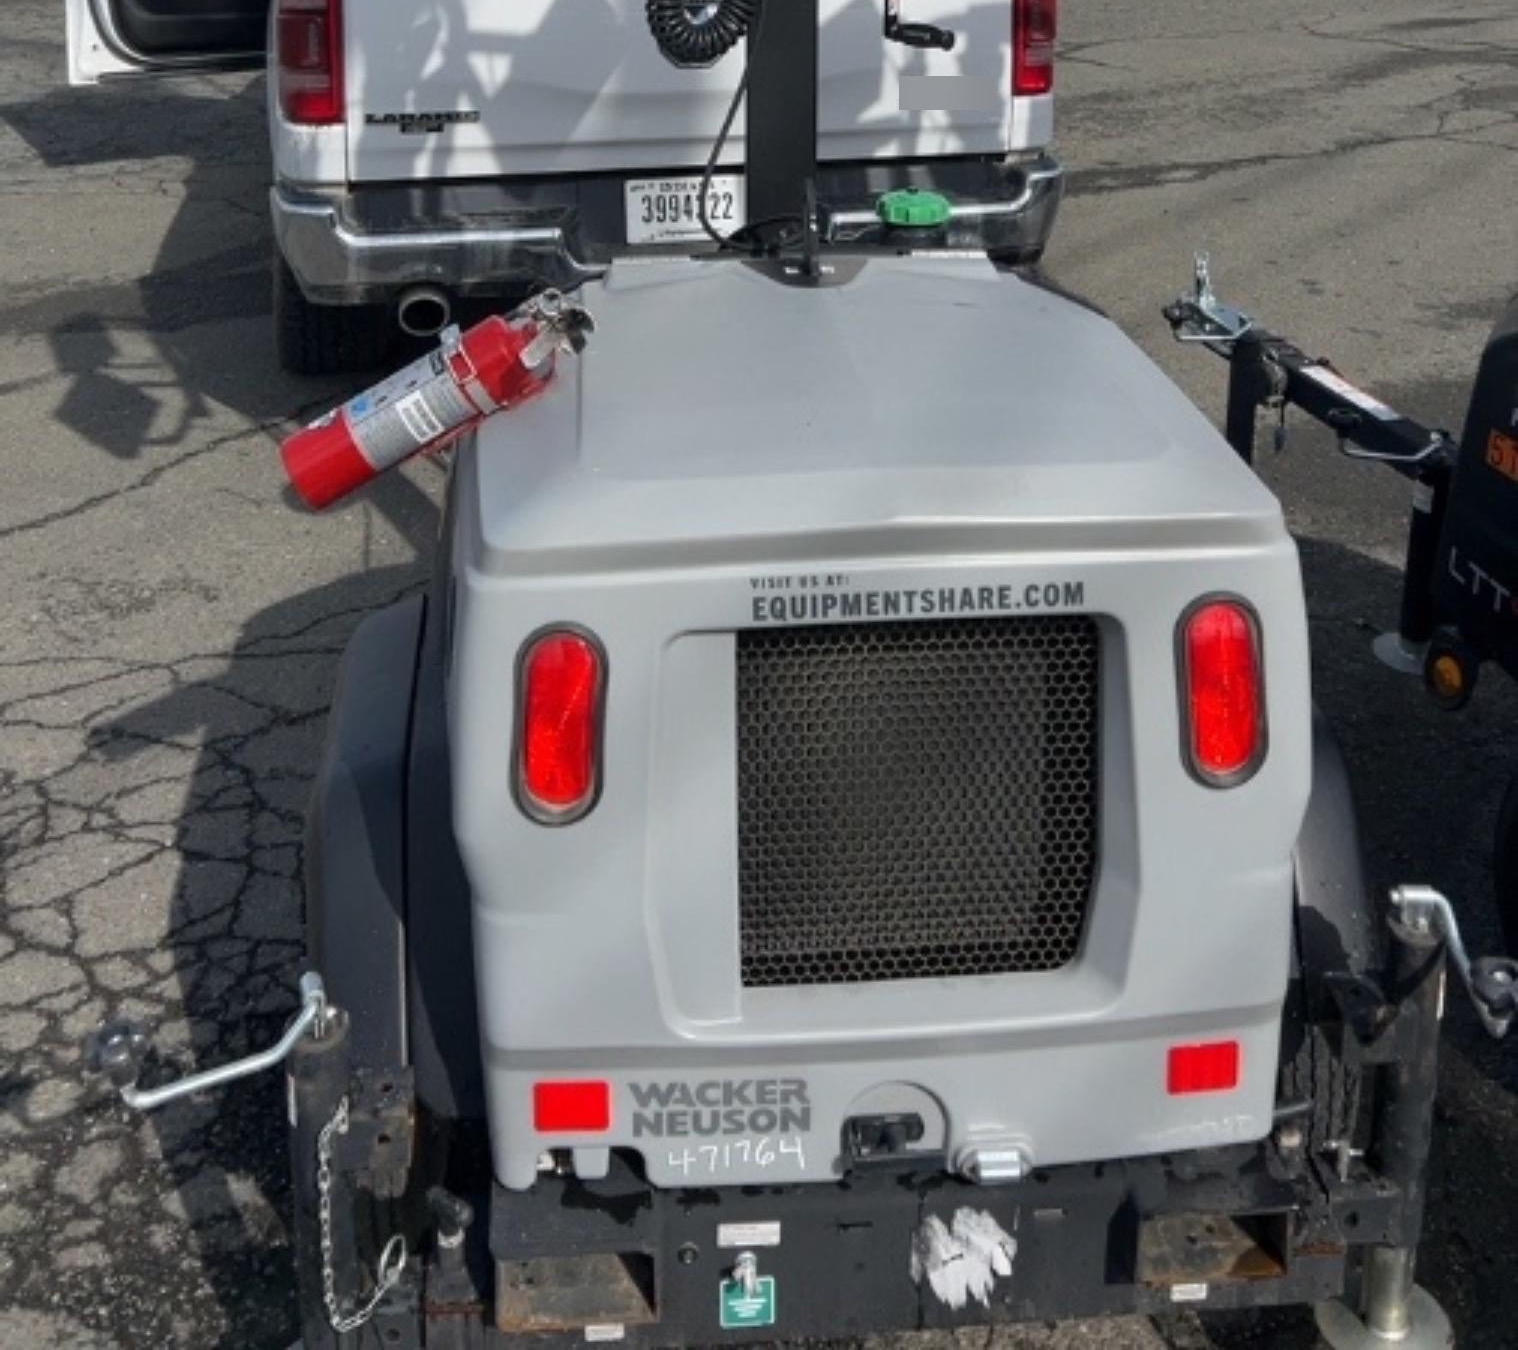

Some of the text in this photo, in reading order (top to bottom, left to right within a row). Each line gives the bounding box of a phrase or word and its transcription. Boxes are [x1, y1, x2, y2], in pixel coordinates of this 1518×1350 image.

[749, 575, 792, 590] VISIT
[752, 581, 1086, 622] EQUIPMENTSHARE.COM
[627, 1079, 810, 1108] WACKER
[632, 1106, 812, 1138] NEUSON
[667, 1135, 806, 1176] 471764
